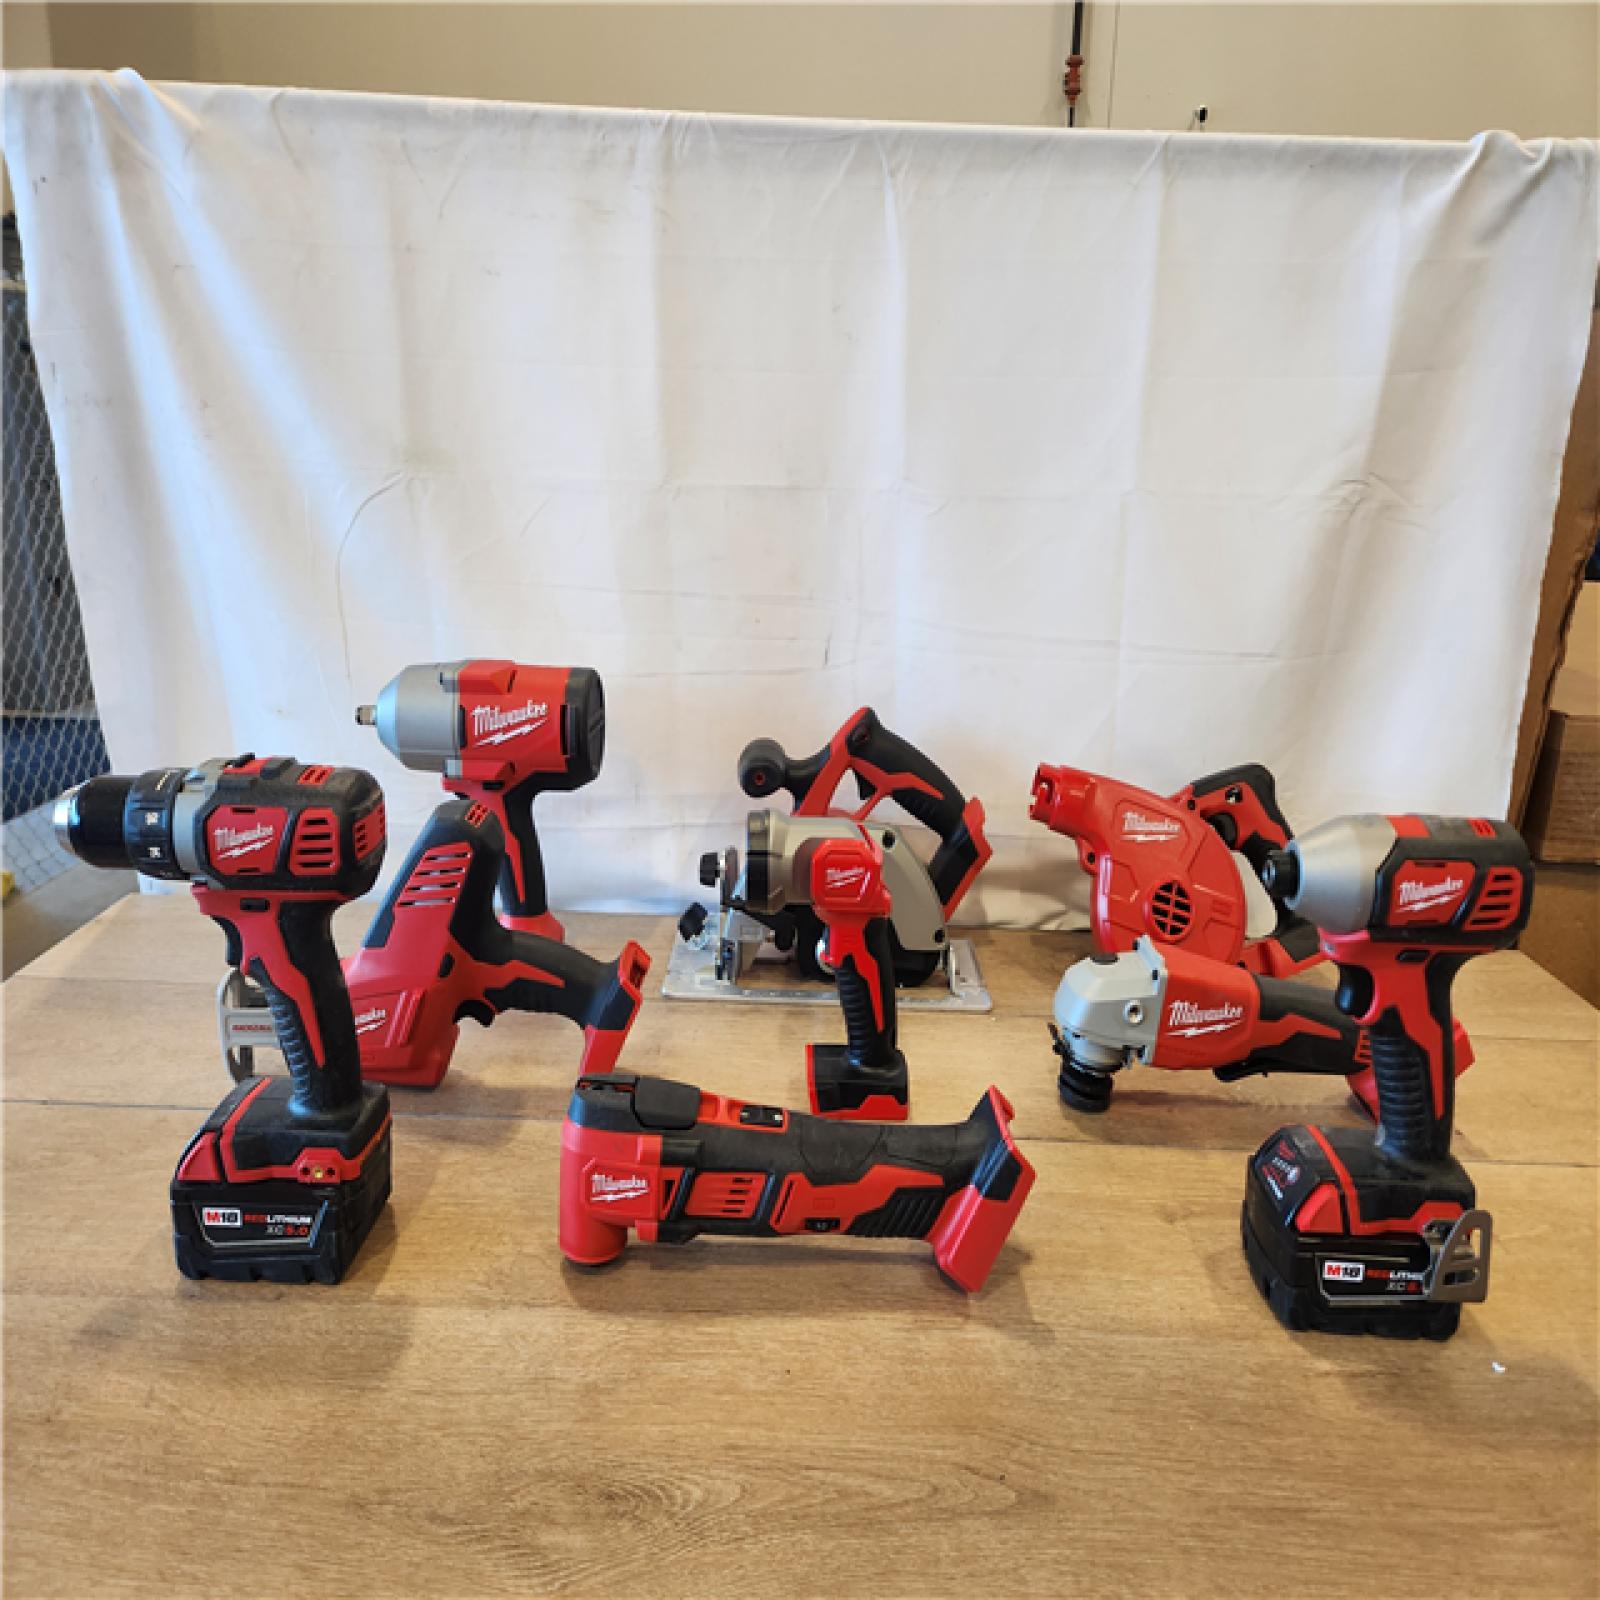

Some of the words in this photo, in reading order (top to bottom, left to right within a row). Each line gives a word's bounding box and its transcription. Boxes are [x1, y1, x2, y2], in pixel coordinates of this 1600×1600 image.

[472, 699, 548, 736] Milwaukee
[1123, 811, 1181, 832] Milwaukee
[214, 822, 274, 851] Milwaukee
[1398, 876, 1464, 905] Milwaukee
[1169, 1000, 1243, 1026] Milwaukee
[591, 1172, 649, 1193] Milwaukee
[206, 1210, 239, 1223] M18
[1326, 1264, 1361, 1278] M18
